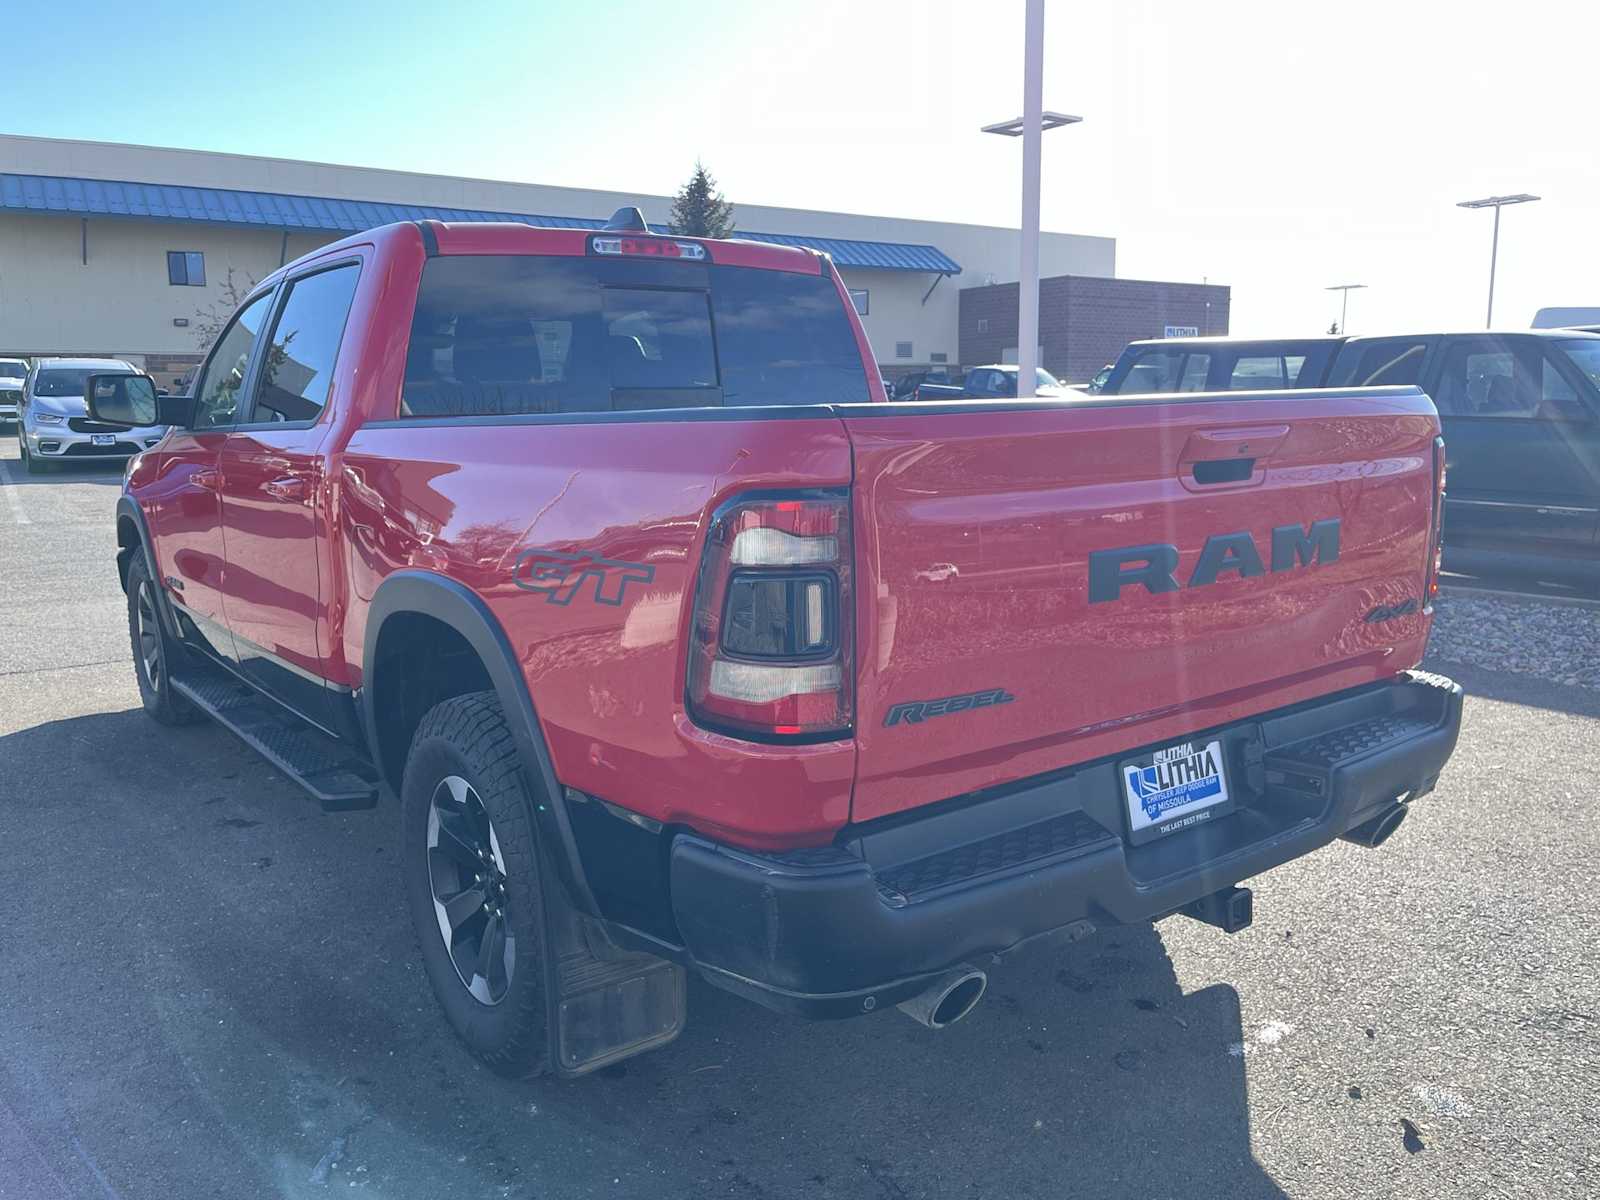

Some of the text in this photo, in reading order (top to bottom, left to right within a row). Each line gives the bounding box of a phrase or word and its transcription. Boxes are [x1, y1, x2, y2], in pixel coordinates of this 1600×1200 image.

[1088, 517, 1341, 604] RAM
[882, 687, 1015, 728] REBEL
[1162, 742, 1194, 762] LITHIA
[1156, 750, 1218, 791] LITHIA
[1147, 793, 1192, 815] OF MISSOULA
[1160, 824, 1171, 833] THE
